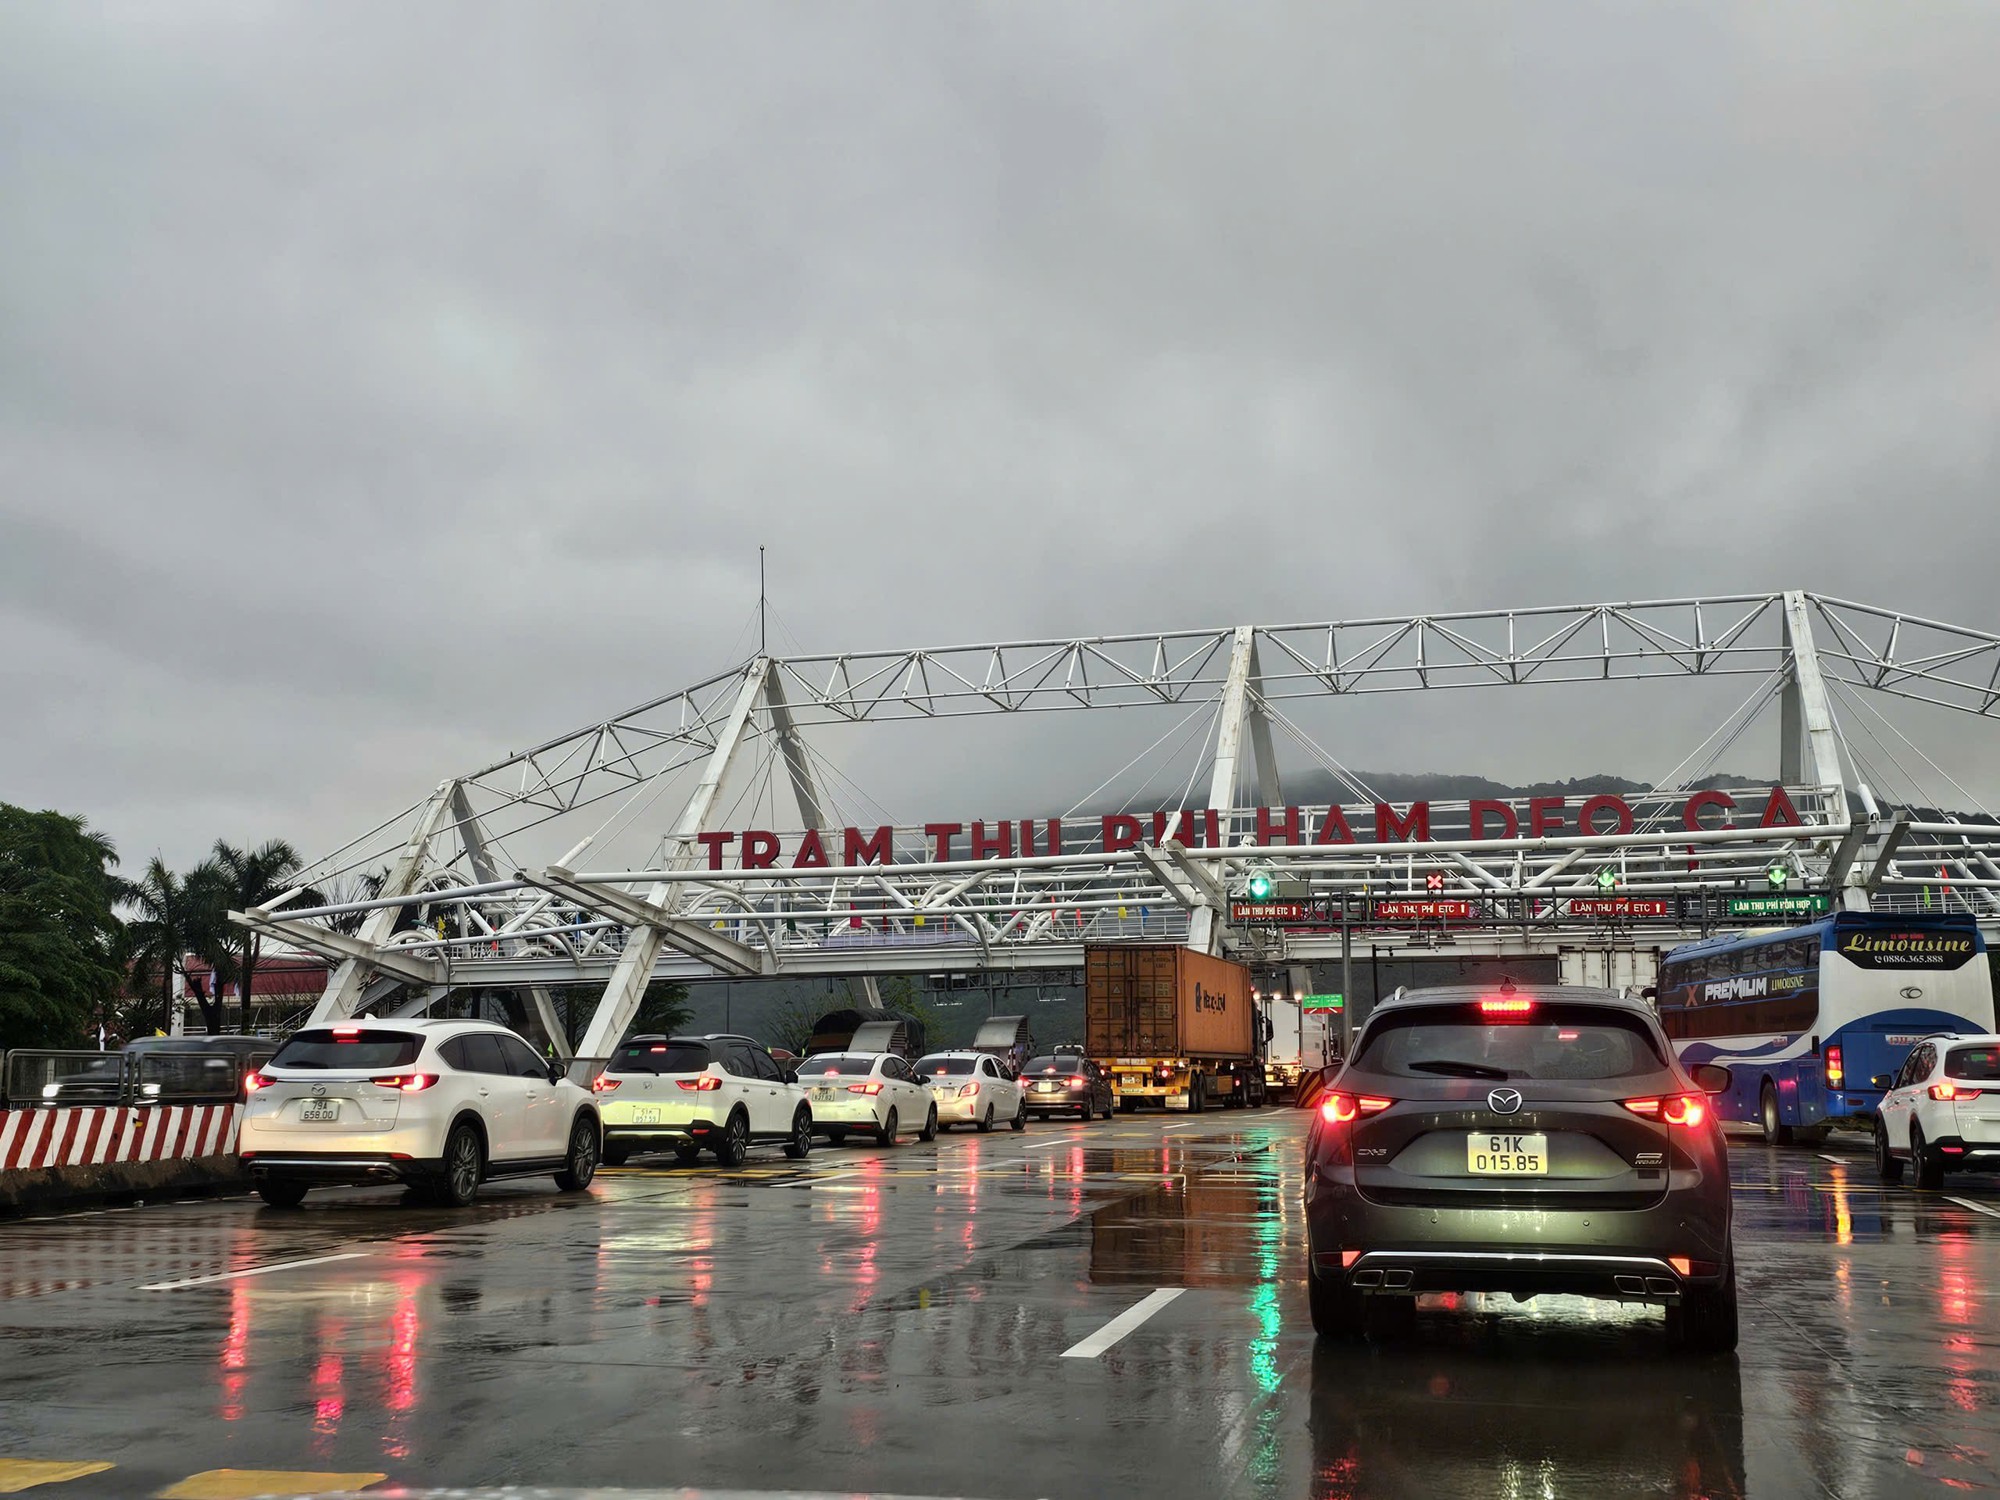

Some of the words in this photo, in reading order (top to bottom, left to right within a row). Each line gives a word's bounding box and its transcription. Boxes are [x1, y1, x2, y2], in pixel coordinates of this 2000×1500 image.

[925, 818, 1061, 862] THU
[1252, 906, 1264, 915] THU
[1277, 906, 1288, 915] ETC
[1382, 903, 1399, 914] LÀN
[1402, 905, 1417, 914] THU
[1421, 903, 1434, 914] PHÍ
[1438, 905, 1455, 913] ETC
[1574, 902, 1592, 912] LÀN
[1596, 903, 1612, 912] THU
[1633, 903, 1651, 912] ETC
[1750, 901, 1765, 910] THU
[1766, 900, 1779, 909] PHÍ
[1843, 933, 1972, 952] Limousine
[1883, 954, 1944, 964] 0886.365.888
[1705, 977, 1767, 1002] PREMIUM
[1771, 975, 1804, 991] LIMOUSINE
[303, 1110, 334, 1120] 658.00
[1490, 1136, 1524, 1153] 61K
[1476, 1154, 1539, 1171] 015.85
